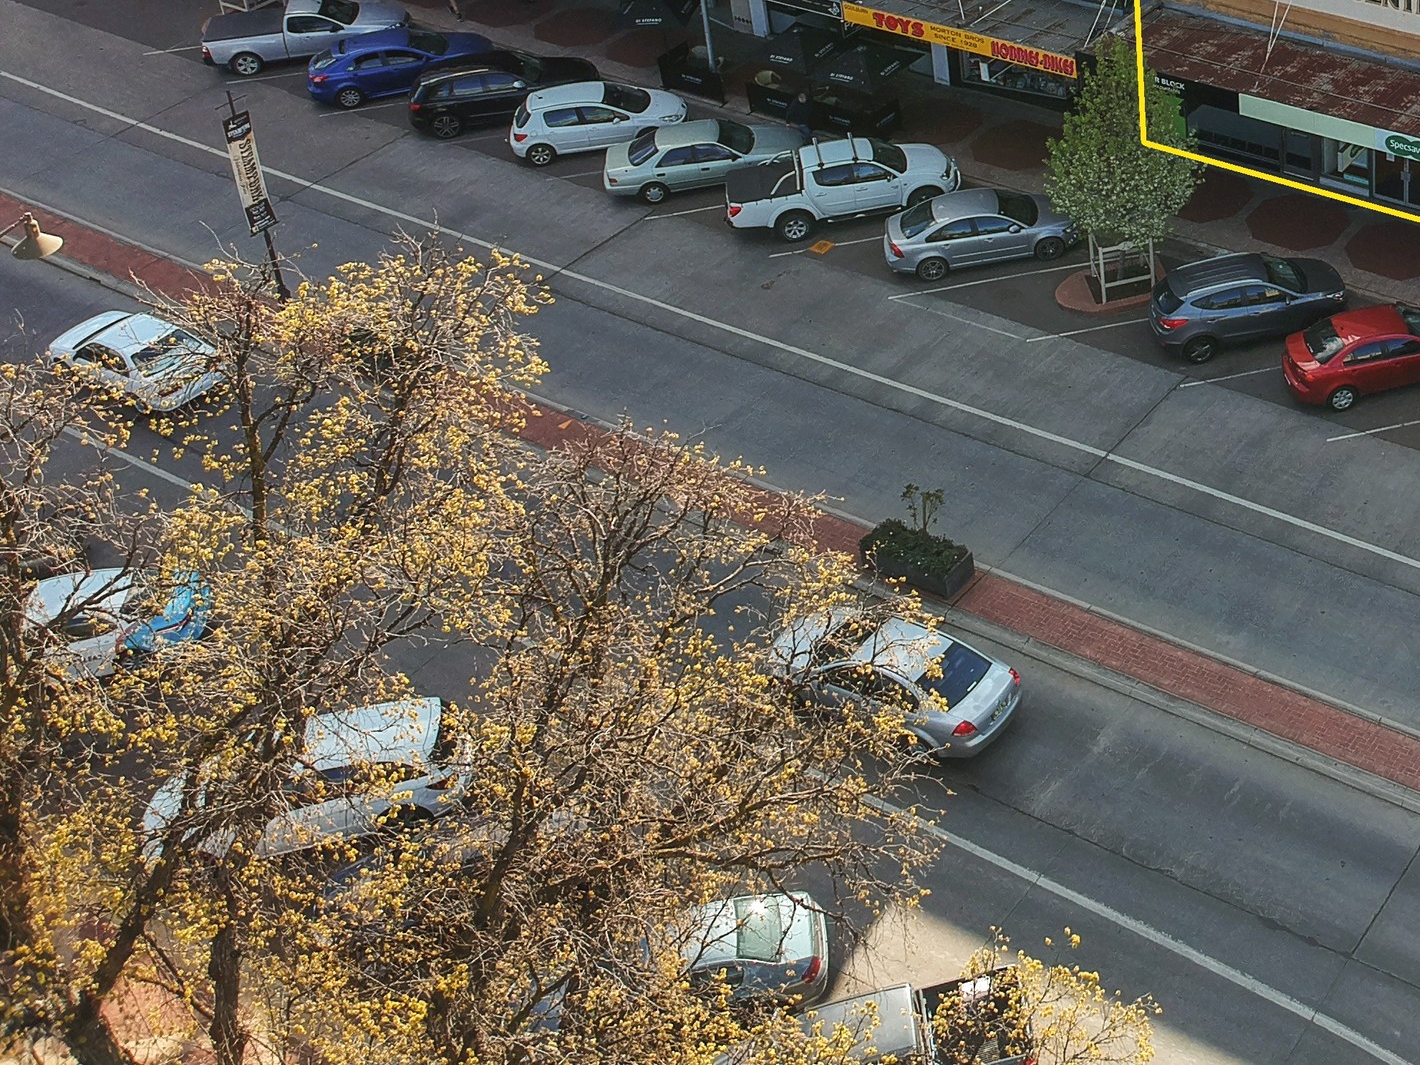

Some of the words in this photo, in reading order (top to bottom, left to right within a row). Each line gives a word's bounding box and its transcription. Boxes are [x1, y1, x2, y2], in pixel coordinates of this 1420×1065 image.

[872, 12, 925, 38] TOYS
[930, 25, 962, 38] MORTON
[964, 33, 985, 44] BROS
[934, 33, 956, 43] SINCE
[1161, 78, 1185, 90] BLOCK
